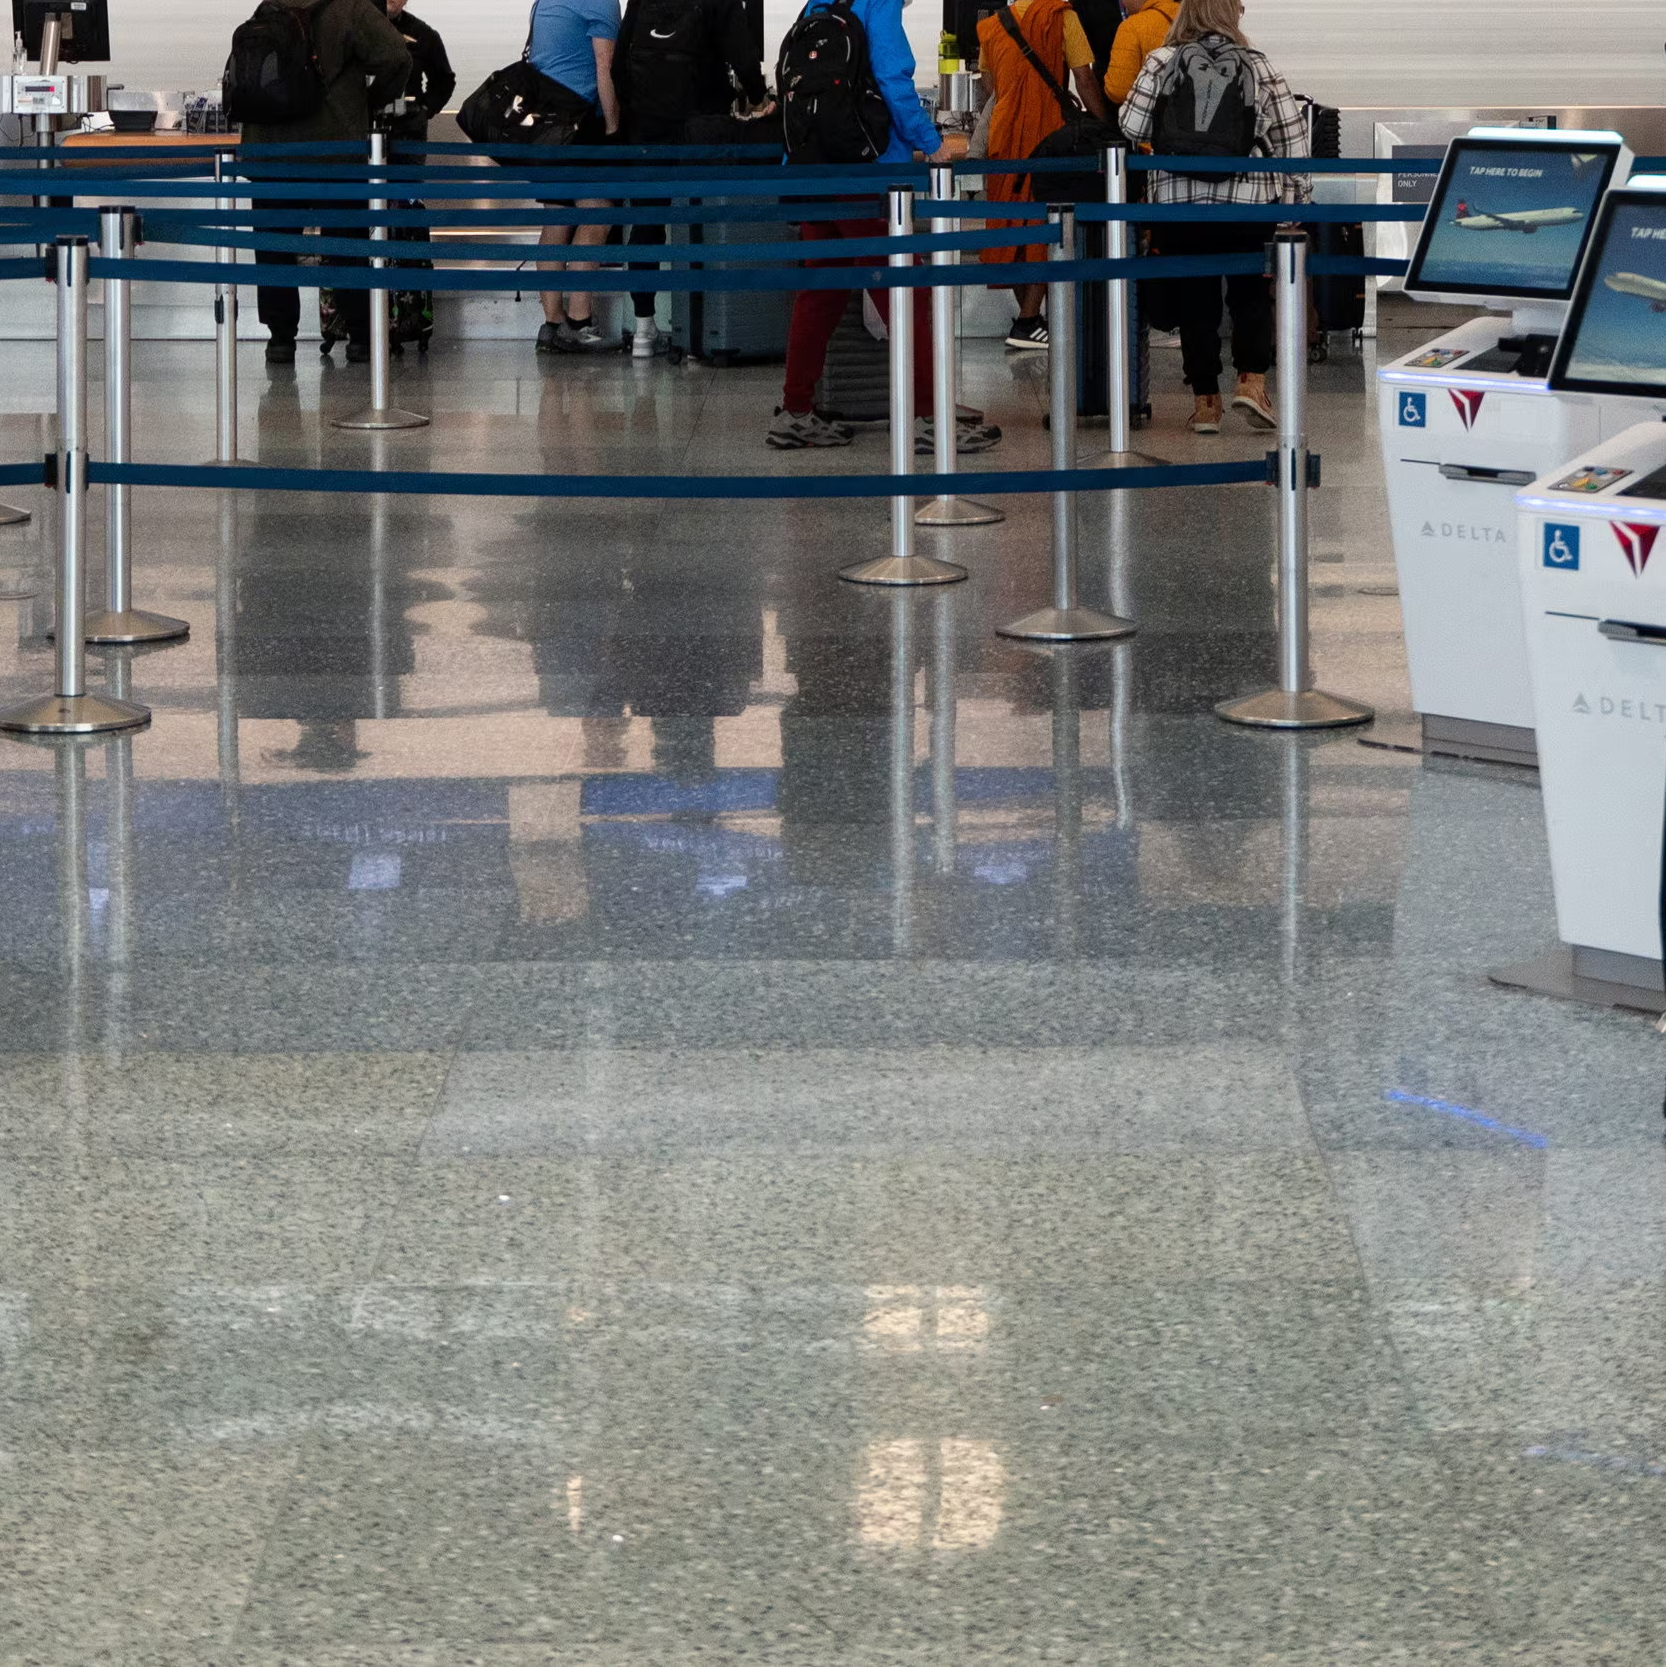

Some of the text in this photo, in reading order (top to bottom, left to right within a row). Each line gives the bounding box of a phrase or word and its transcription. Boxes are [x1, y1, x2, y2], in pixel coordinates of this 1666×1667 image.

[1470, 166, 1544, 178] TAP HERE TO BEGIN
[1631, 227, 1652, 239] TAP
[1441, 522, 1506, 543] DELTA
